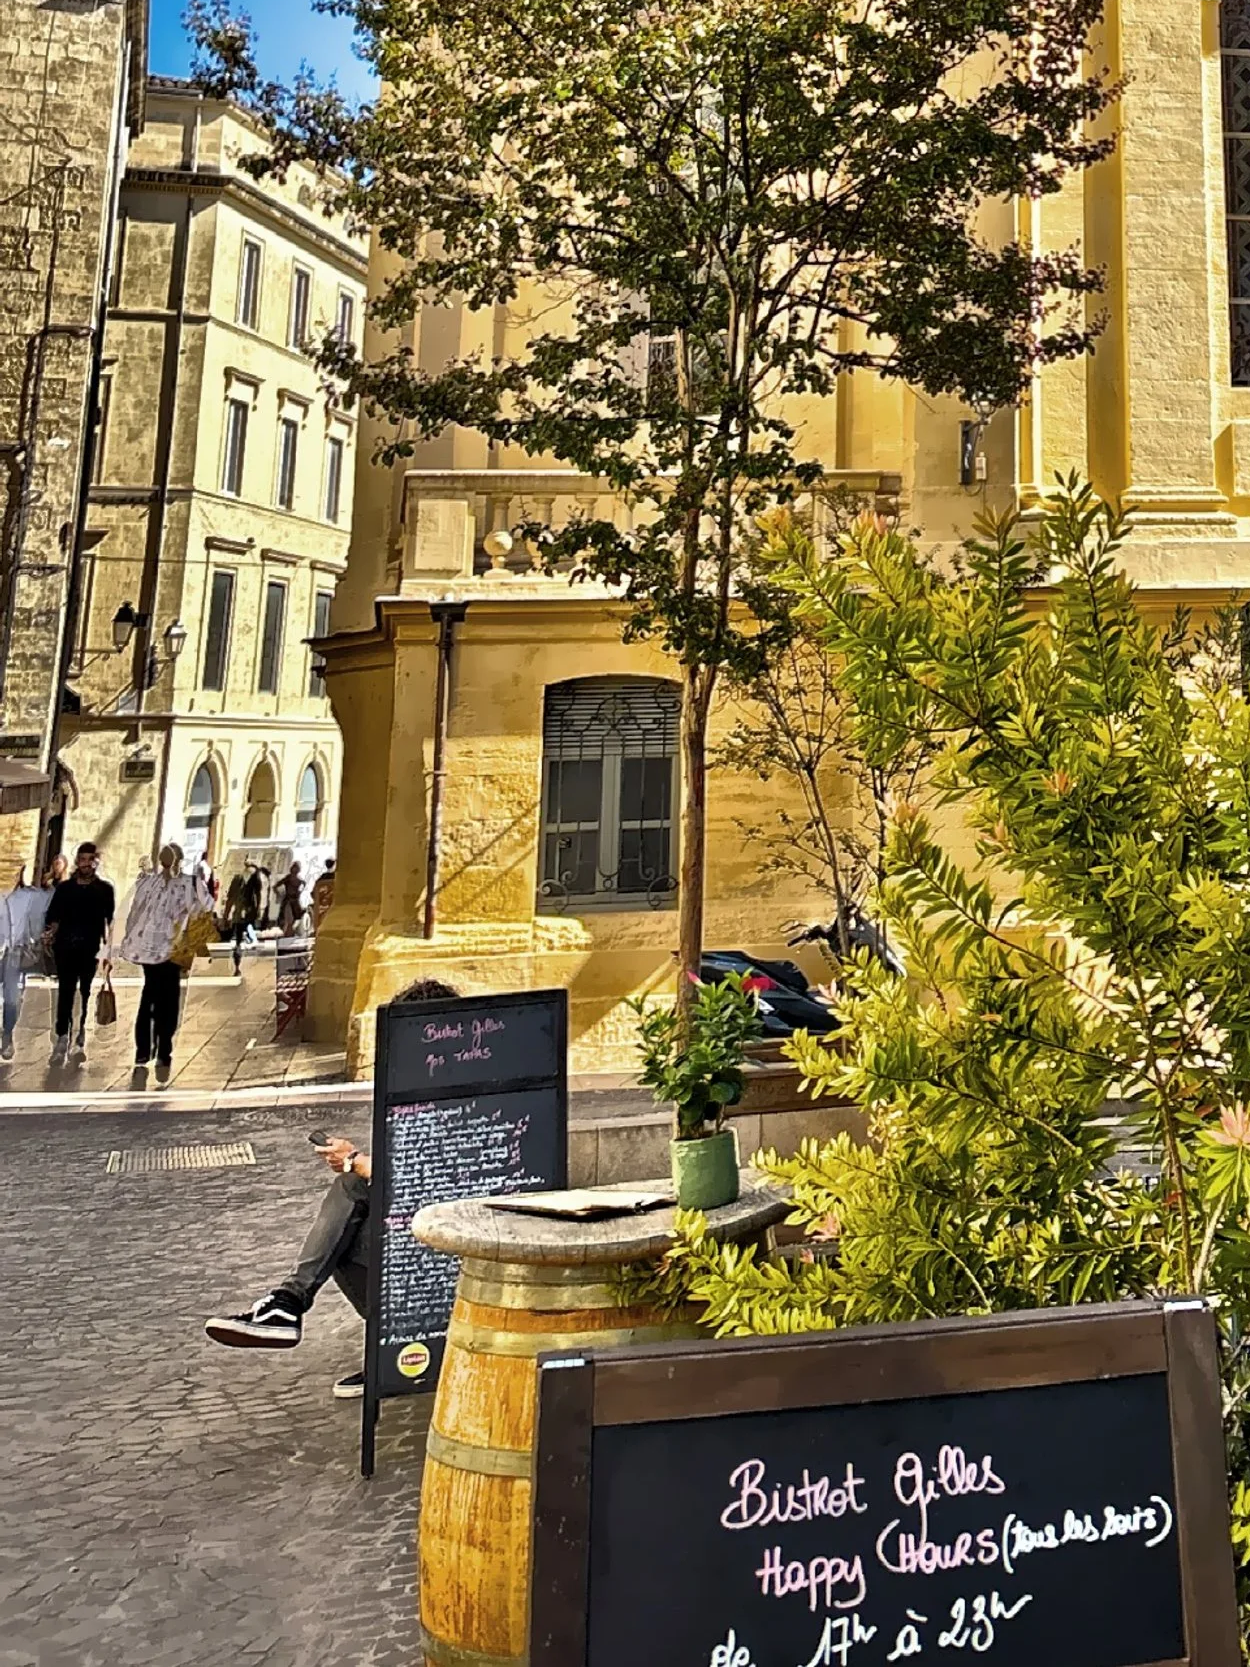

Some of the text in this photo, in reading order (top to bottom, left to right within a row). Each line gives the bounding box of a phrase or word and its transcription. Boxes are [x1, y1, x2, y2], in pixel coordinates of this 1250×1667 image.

[720, 1443, 1006, 1547] Bistrot Gilles
[755, 1545, 867, 1612] Happy
